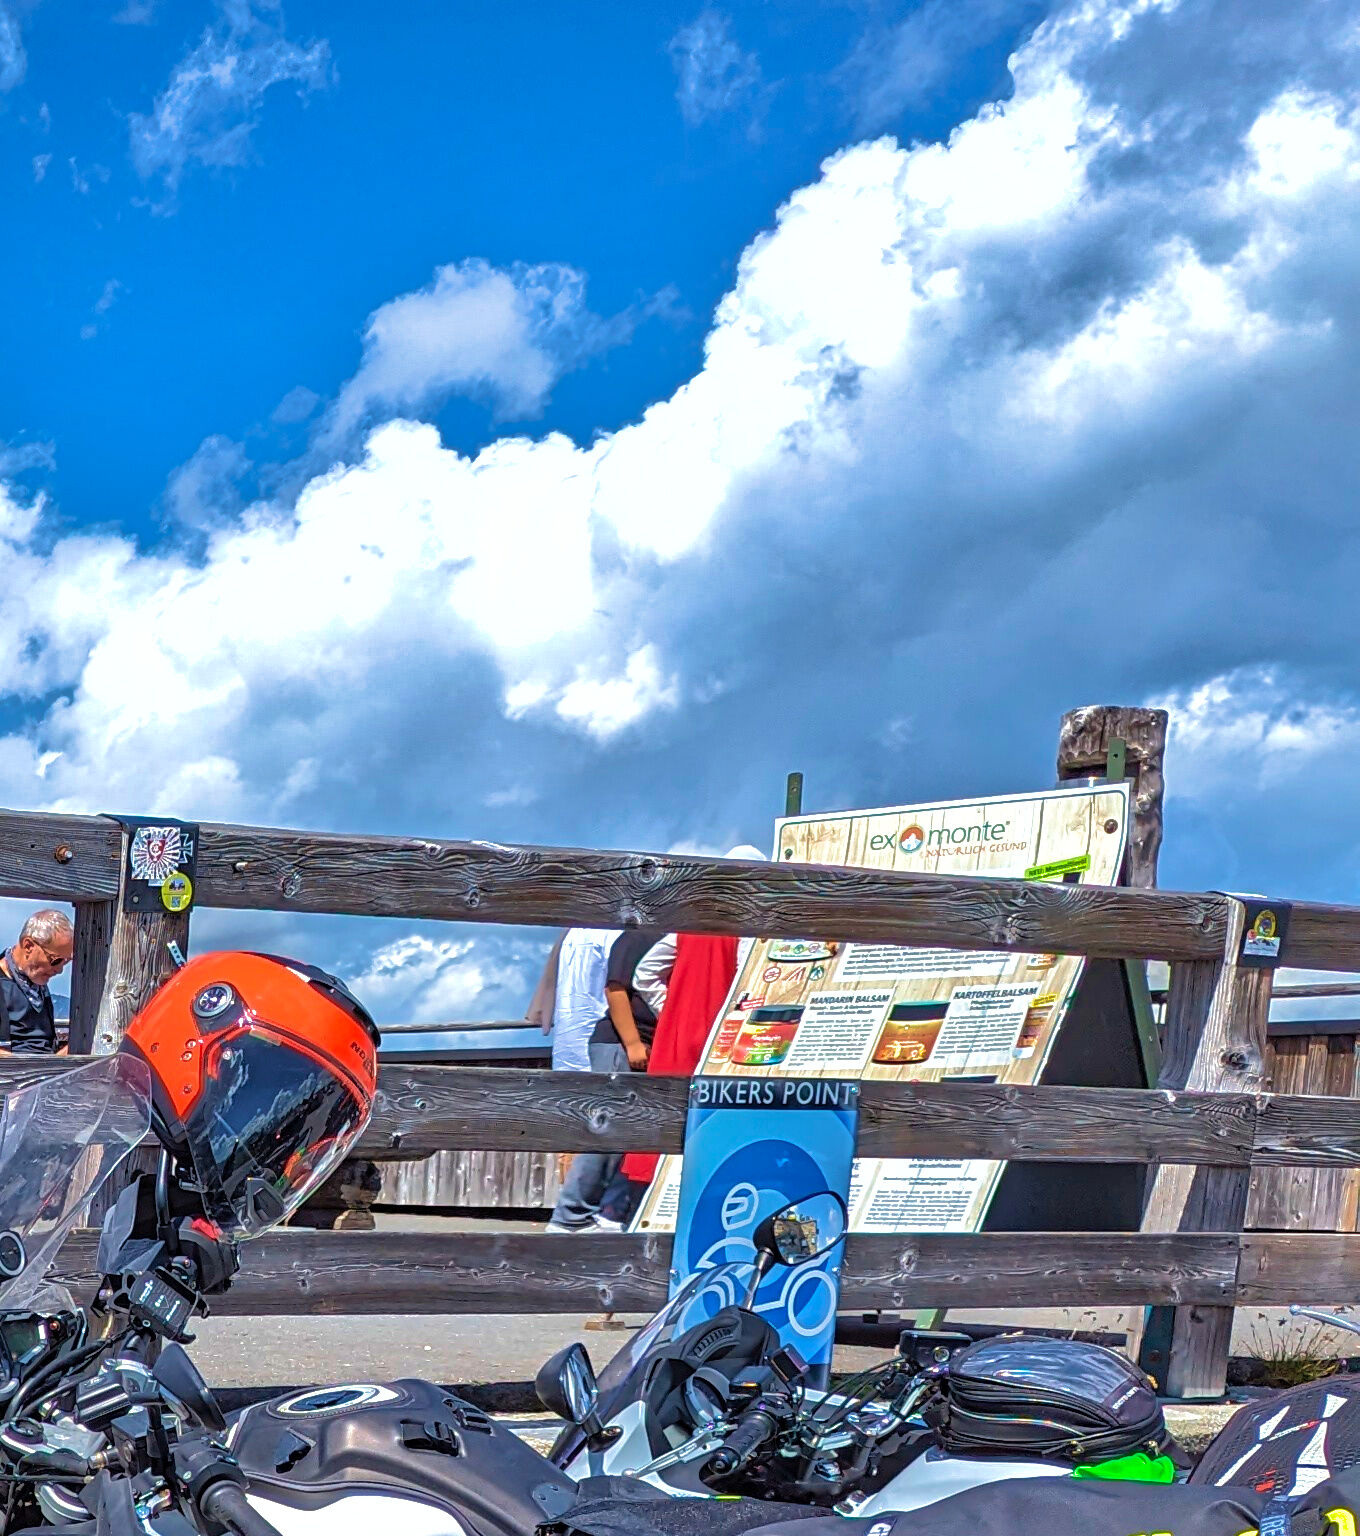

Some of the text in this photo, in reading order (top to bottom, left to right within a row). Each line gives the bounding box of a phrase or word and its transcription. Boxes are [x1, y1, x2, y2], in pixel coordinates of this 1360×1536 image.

[989, 841, 1027, 853] GESUND
[810, 994, 890, 1005] MANDARIN BALSAM
[953, 987, 1038, 1000] KARTOFFELBALSAM
[696, 1079, 855, 1105] BIKERS POINT
